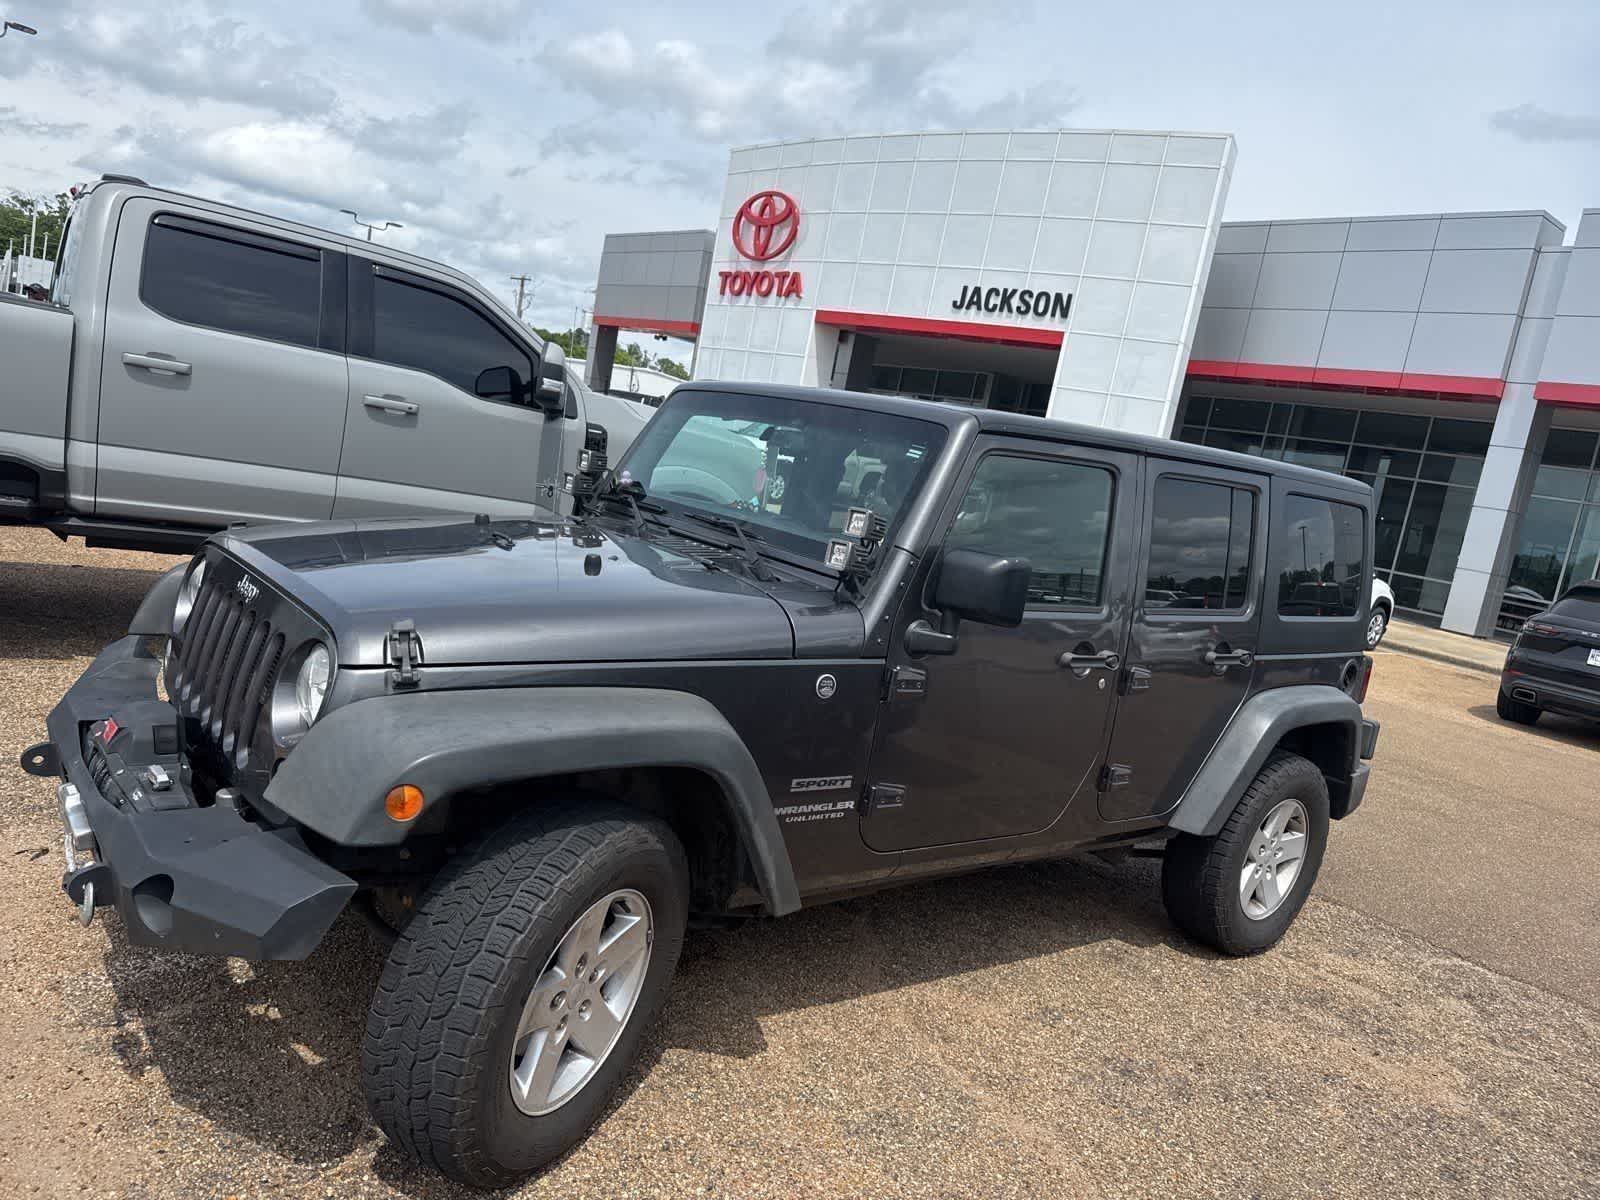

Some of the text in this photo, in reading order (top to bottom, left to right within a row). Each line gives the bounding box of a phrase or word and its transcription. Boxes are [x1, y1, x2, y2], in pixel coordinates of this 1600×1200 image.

[719, 270, 803, 299] TOYOTA
[952, 285, 1073, 319] JACKSON
[794, 778, 850, 788] SPORT
[774, 801, 855, 815] WRANGLER
[785, 812, 845, 823] UNLIMITED
